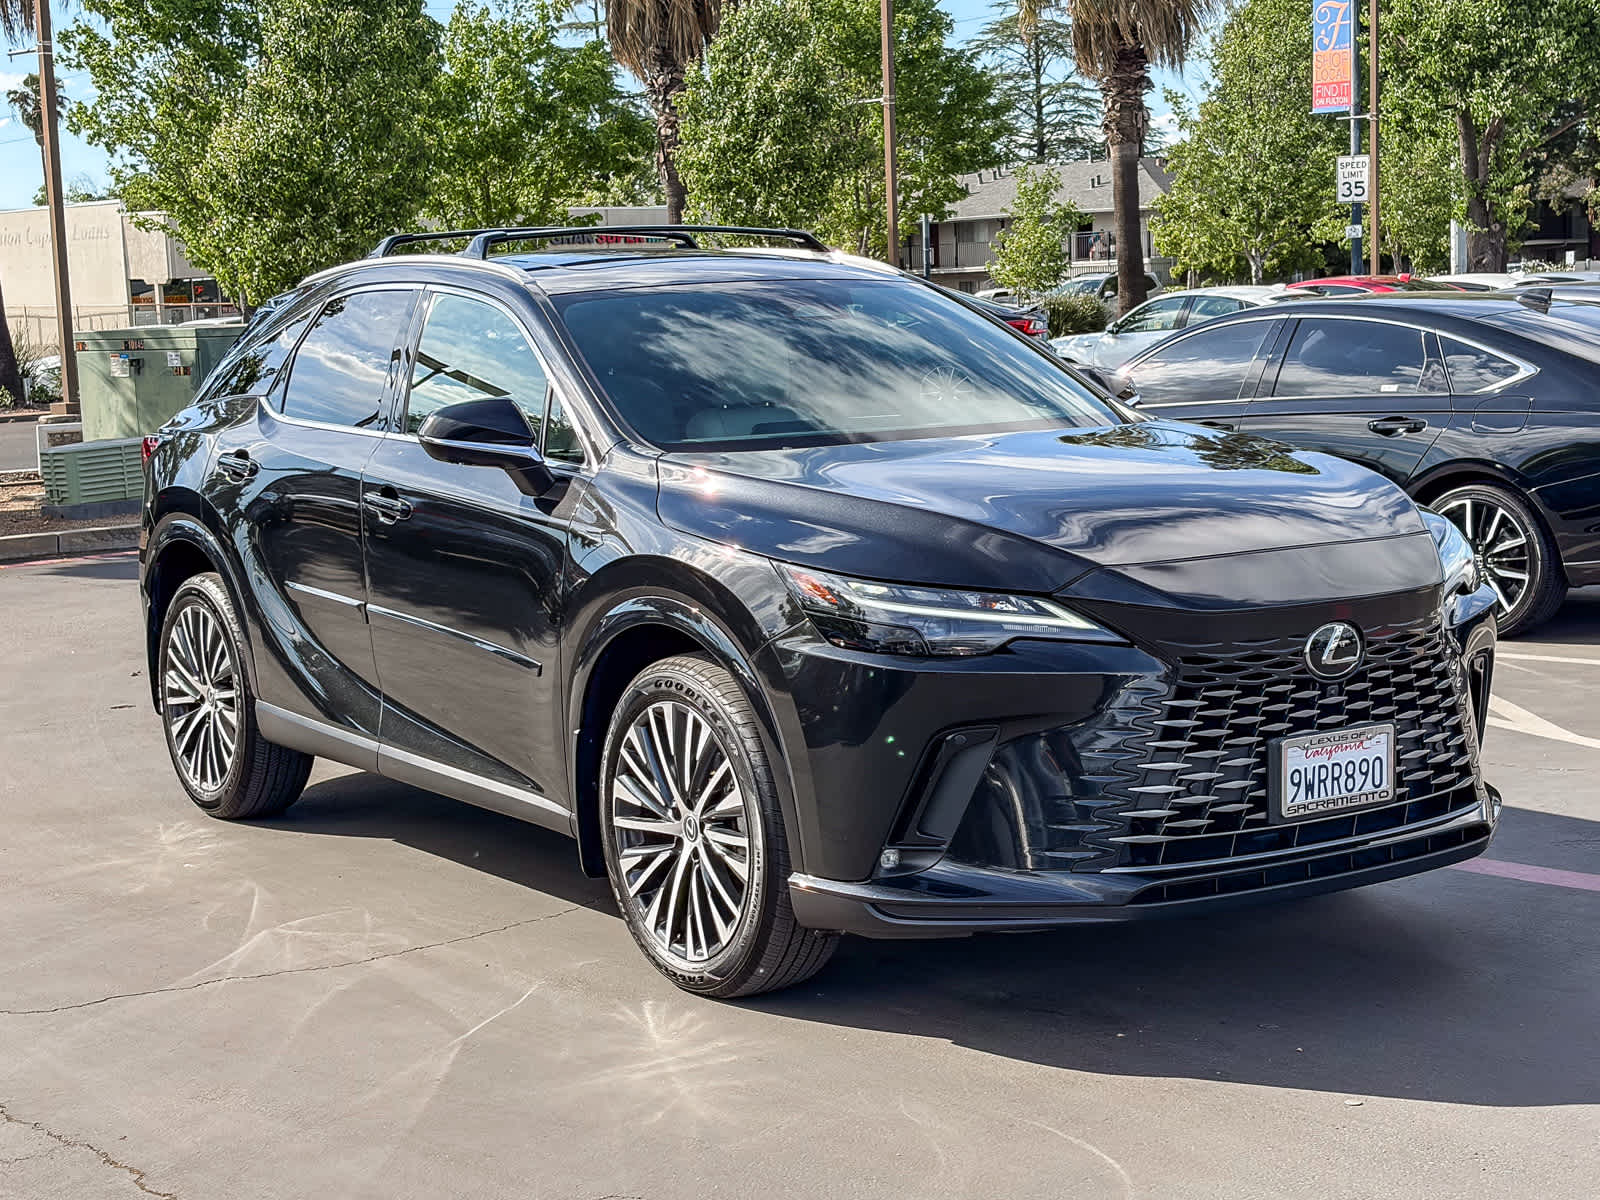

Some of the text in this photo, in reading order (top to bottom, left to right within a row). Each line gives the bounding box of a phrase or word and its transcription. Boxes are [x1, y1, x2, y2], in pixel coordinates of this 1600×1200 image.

[1315, 51, 1348, 69] SHOP
[1315, 68, 1348, 82] LOCAL
[1316, 83, 1349, 97] FIND IT
[1325, 96, 1348, 105] FULTON
[1340, 161, 1367, 169] SPEED
[1343, 171, 1364, 179] LIMIT
[1342, 181, 1365, 197] 35
[1310, 732, 1367, 746] LEXUS OF
[1305, 741, 1369, 760] California
[1290, 756, 1383, 803] 9WRR890
[1287, 791, 1389, 815] SACRAMENTO
